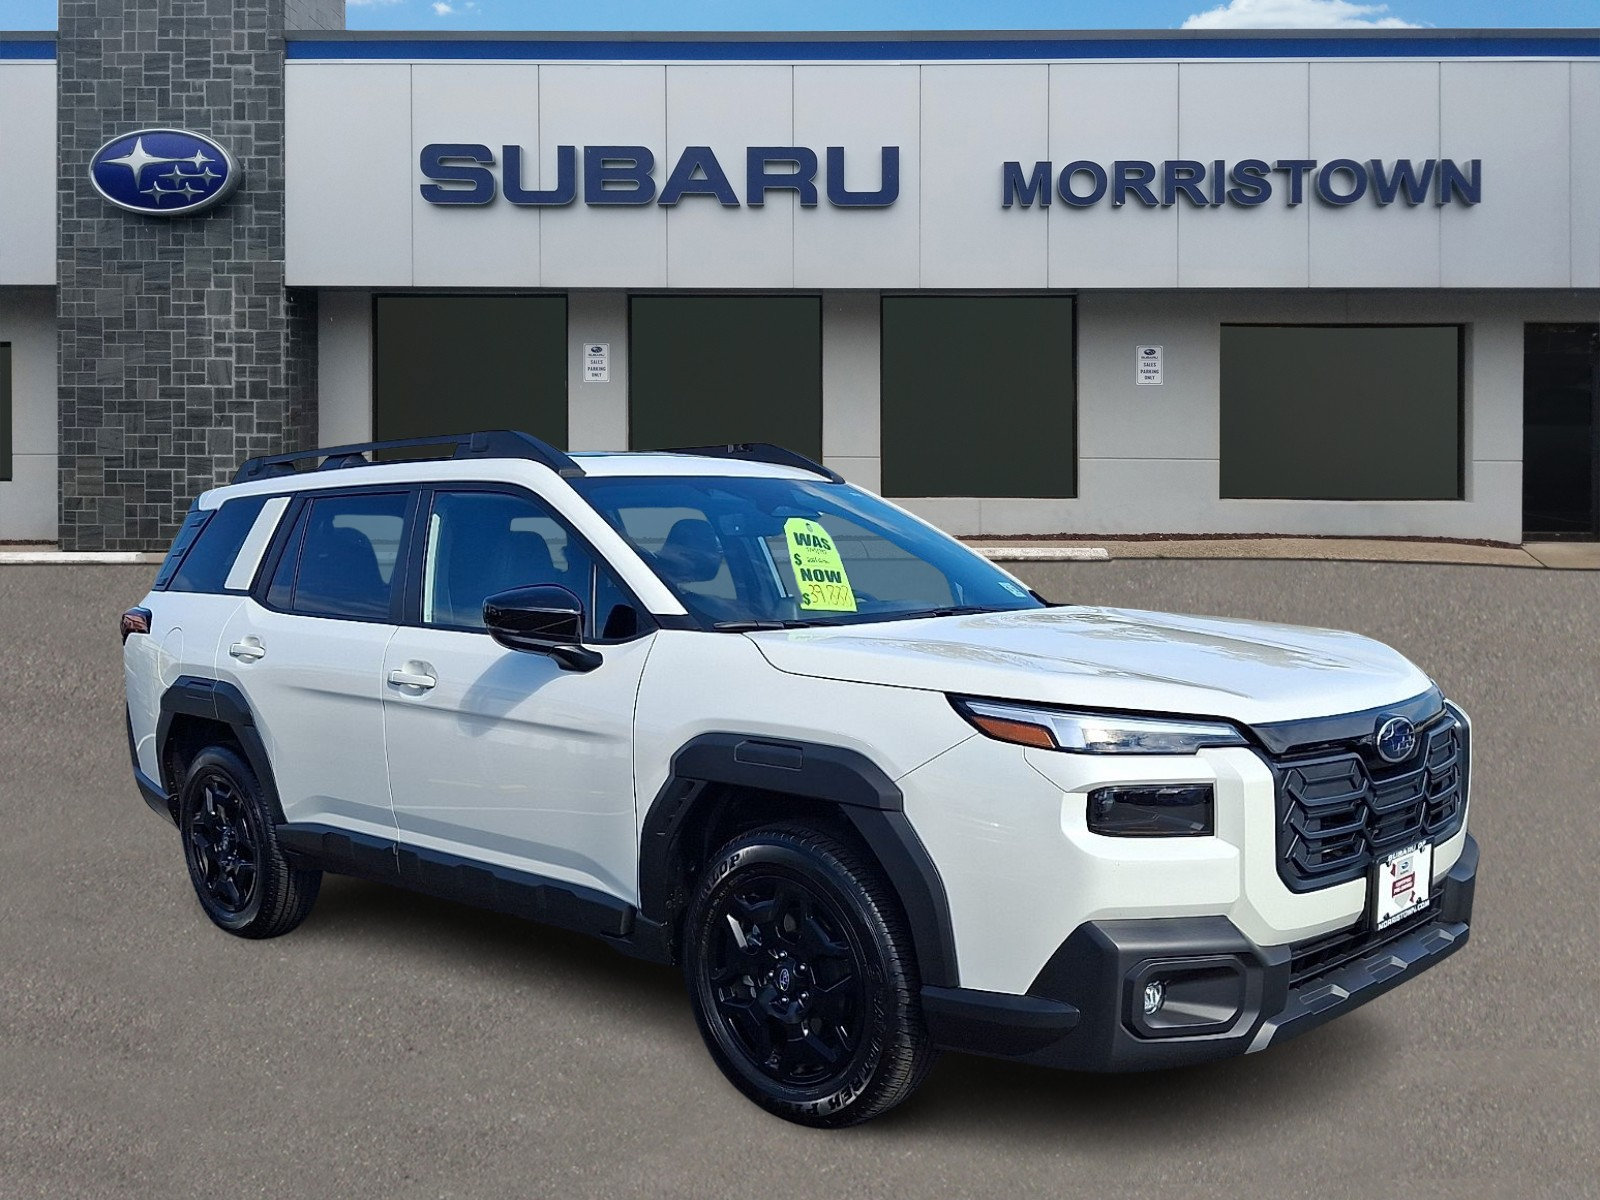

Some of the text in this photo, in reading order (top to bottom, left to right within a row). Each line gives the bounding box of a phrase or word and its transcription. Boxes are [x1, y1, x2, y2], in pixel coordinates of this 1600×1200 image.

[420, 143, 900, 207] SUBARU
[1002, 158, 1482, 208] MORRISTOWN
[793, 531, 831, 551] WAS
[800, 568, 842, 584] NOW
